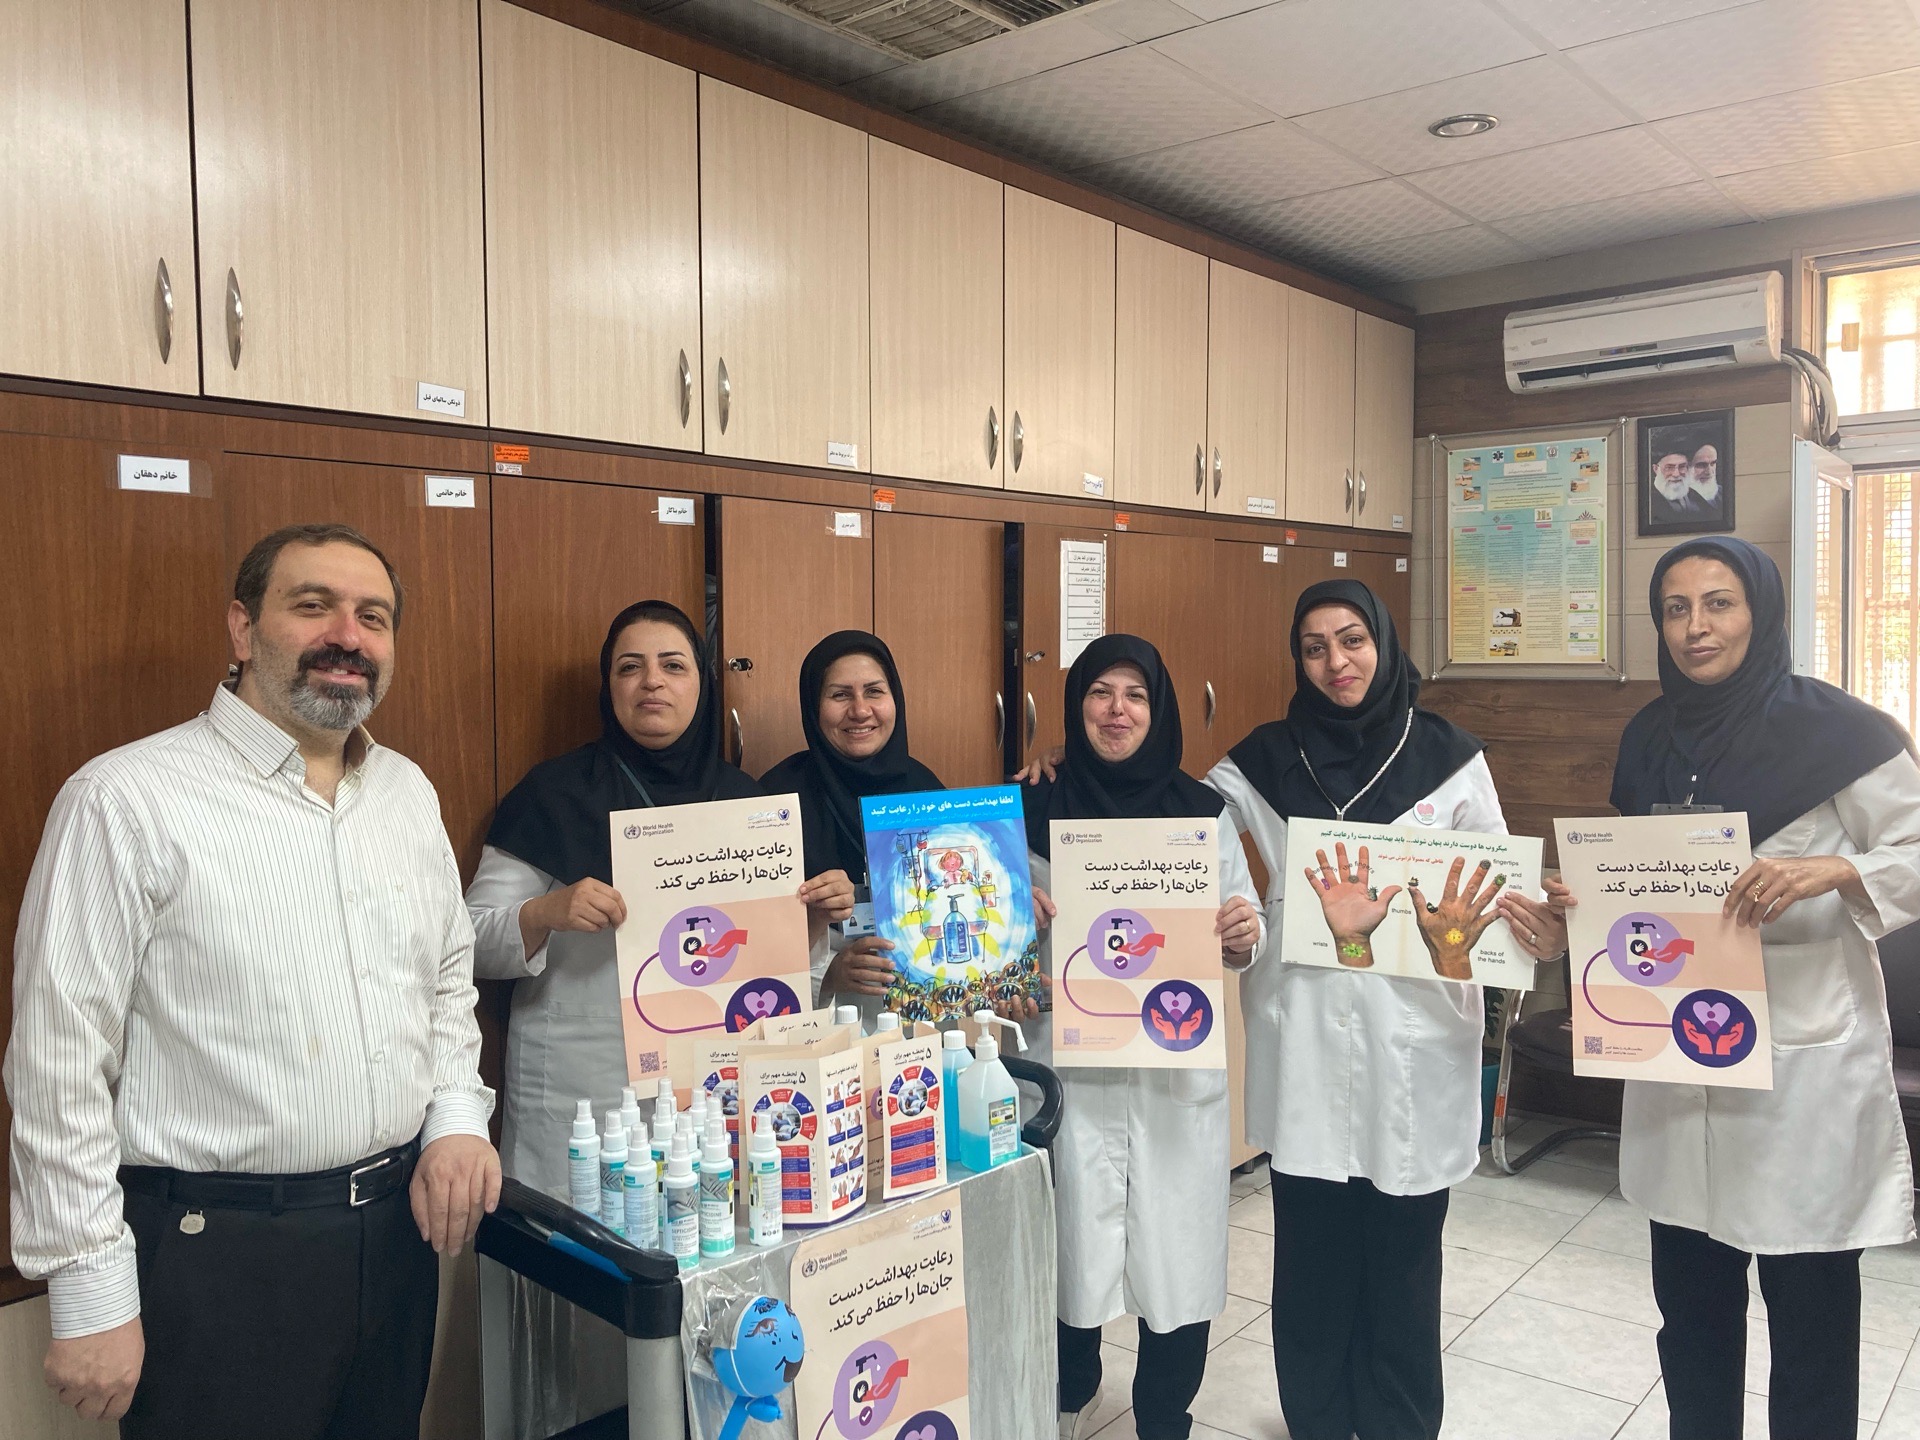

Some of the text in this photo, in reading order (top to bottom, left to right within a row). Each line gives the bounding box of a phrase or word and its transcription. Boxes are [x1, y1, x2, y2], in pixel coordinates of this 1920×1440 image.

[134, 469, 178, 480] خانم دهقان
[454, 489, 467, 498] خانم
[938, 802, 952, 812] های
[954, 800, 970, 808] دست
[972, 797, 998, 807] بهداشت
[871, 806, 886, 816] کنید
[888, 804, 912, 815] رعایت
[912, 804, 920, 814] را
[922, 804, 936, 814] خود
[657, 822, 674, 830] Health
[642, 828, 674, 837] Organization
[1321, 830, 1332, 838] کنیم
[1334, 831, 1350, 839] رعایت
[1351, 832, 1357, 840] را
[1372, 834, 1393, 843] بهداشت
[1394, 835, 1405, 844] باید
[1427, 840, 1442, 848] پنهان
[1443, 840, 1459, 848] دارند
[1460, 842, 1477, 850] دوست
[1485, 843, 1508, 852] میکروب
[654, 842, 792, 867] رعایت بهداشت دست
[1084, 859, 1208, 874] رعایت بهداشت دست
[1596, 859, 1740, 876] رعایت بهداشت دست
[708, 870, 738, 884] حفظ
[742, 868, 752, 883] را
[686, 877, 704, 890] می
[1112, 883, 1128, 894] می
[1131, 878, 1158, 890] حفظ
[1161, 878, 1170, 893] را
[1650, 880, 1680, 893] حفظ
[1685, 881, 1694, 897] را
[1629, 886, 1647, 897] می
[926, 1047, 931, 1058] ۵
[799, 1071, 806, 1084] ۵
[818, 1248, 848, 1264] World Health
[819, 1256, 848, 1271] Organization
[829, 1250, 953, 1306] رعایت بهداشت دست
[906, 1286, 915, 1305] را
[876, 1291, 902, 1314] حفظ
[856, 1307, 872, 1325] می
